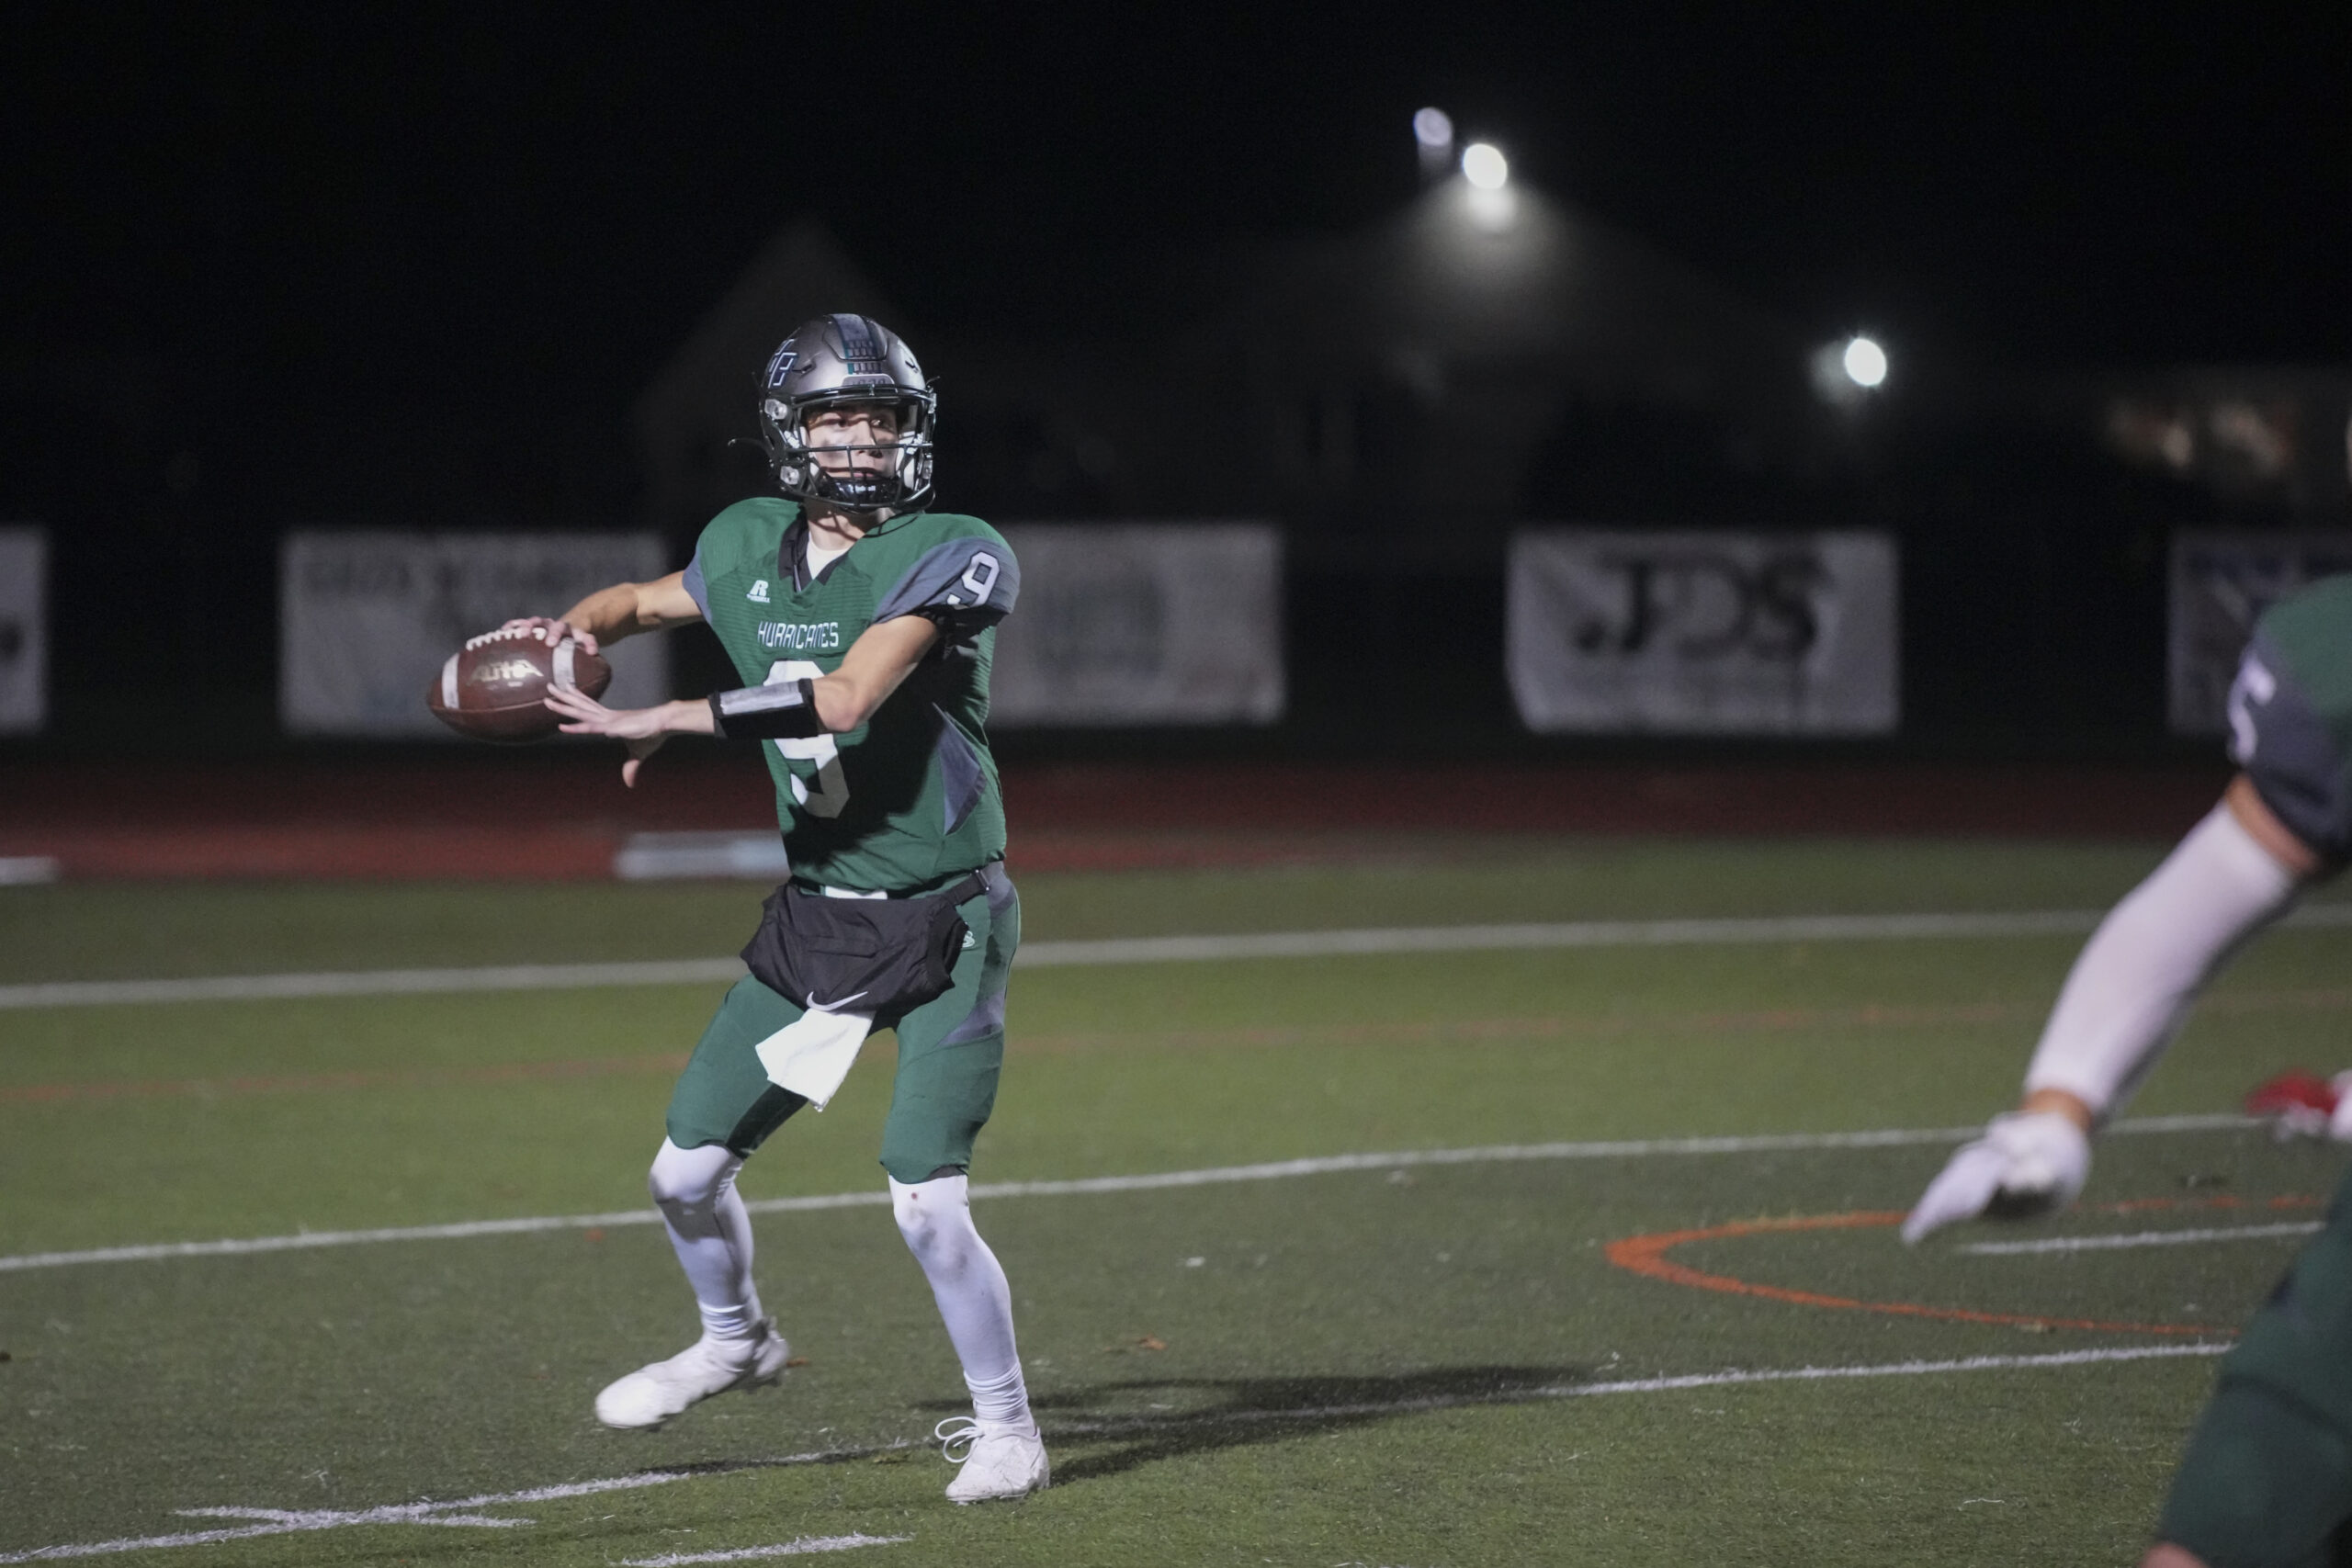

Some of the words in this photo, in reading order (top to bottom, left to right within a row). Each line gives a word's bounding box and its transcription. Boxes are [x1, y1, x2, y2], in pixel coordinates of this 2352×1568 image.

[946, 551, 1000, 610] 9
[1573, 547, 1832, 660] JDS
[757, 621, 840, 649] HURRICANES
[762, 657, 851, 819] 9
